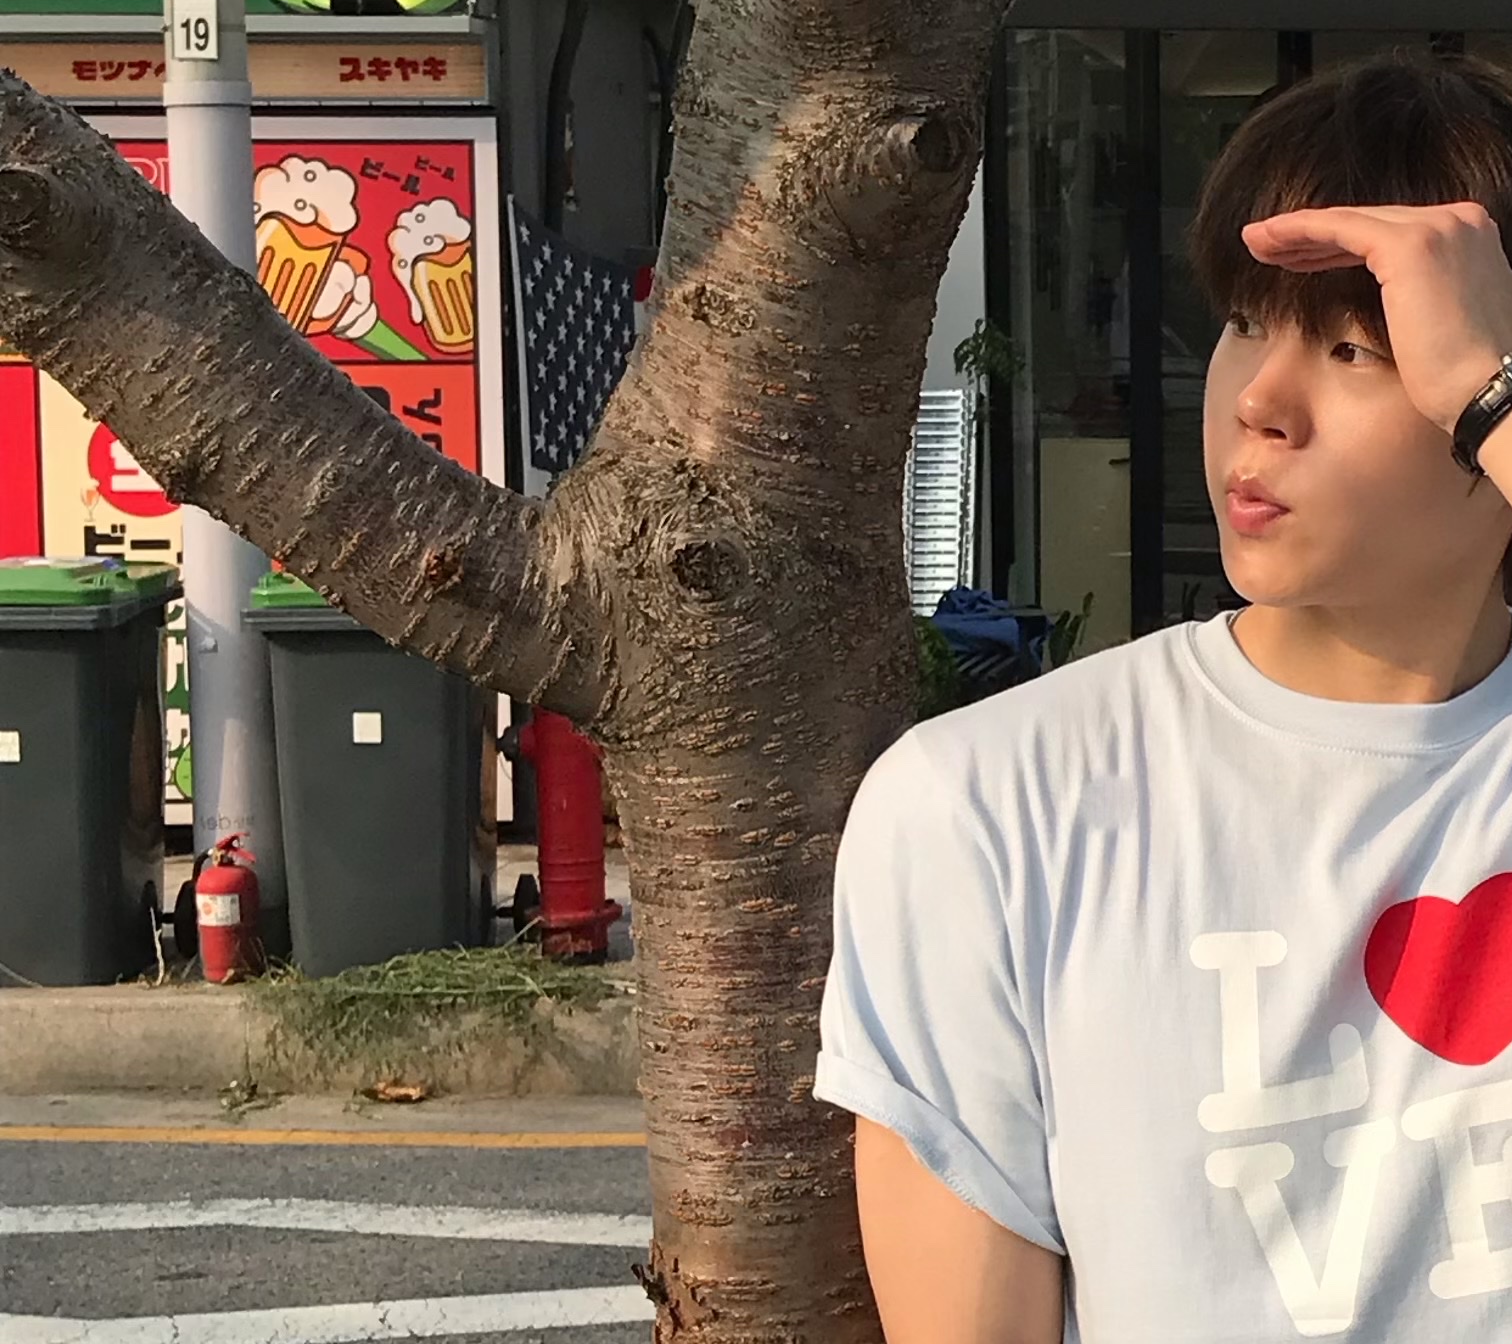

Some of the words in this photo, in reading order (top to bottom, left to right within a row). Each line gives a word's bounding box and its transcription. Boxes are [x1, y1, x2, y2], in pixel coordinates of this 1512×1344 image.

[180, 17, 210, 52] 19
[339, 56, 447, 82] スキヤキ
[84, 523, 184, 564] ビー
